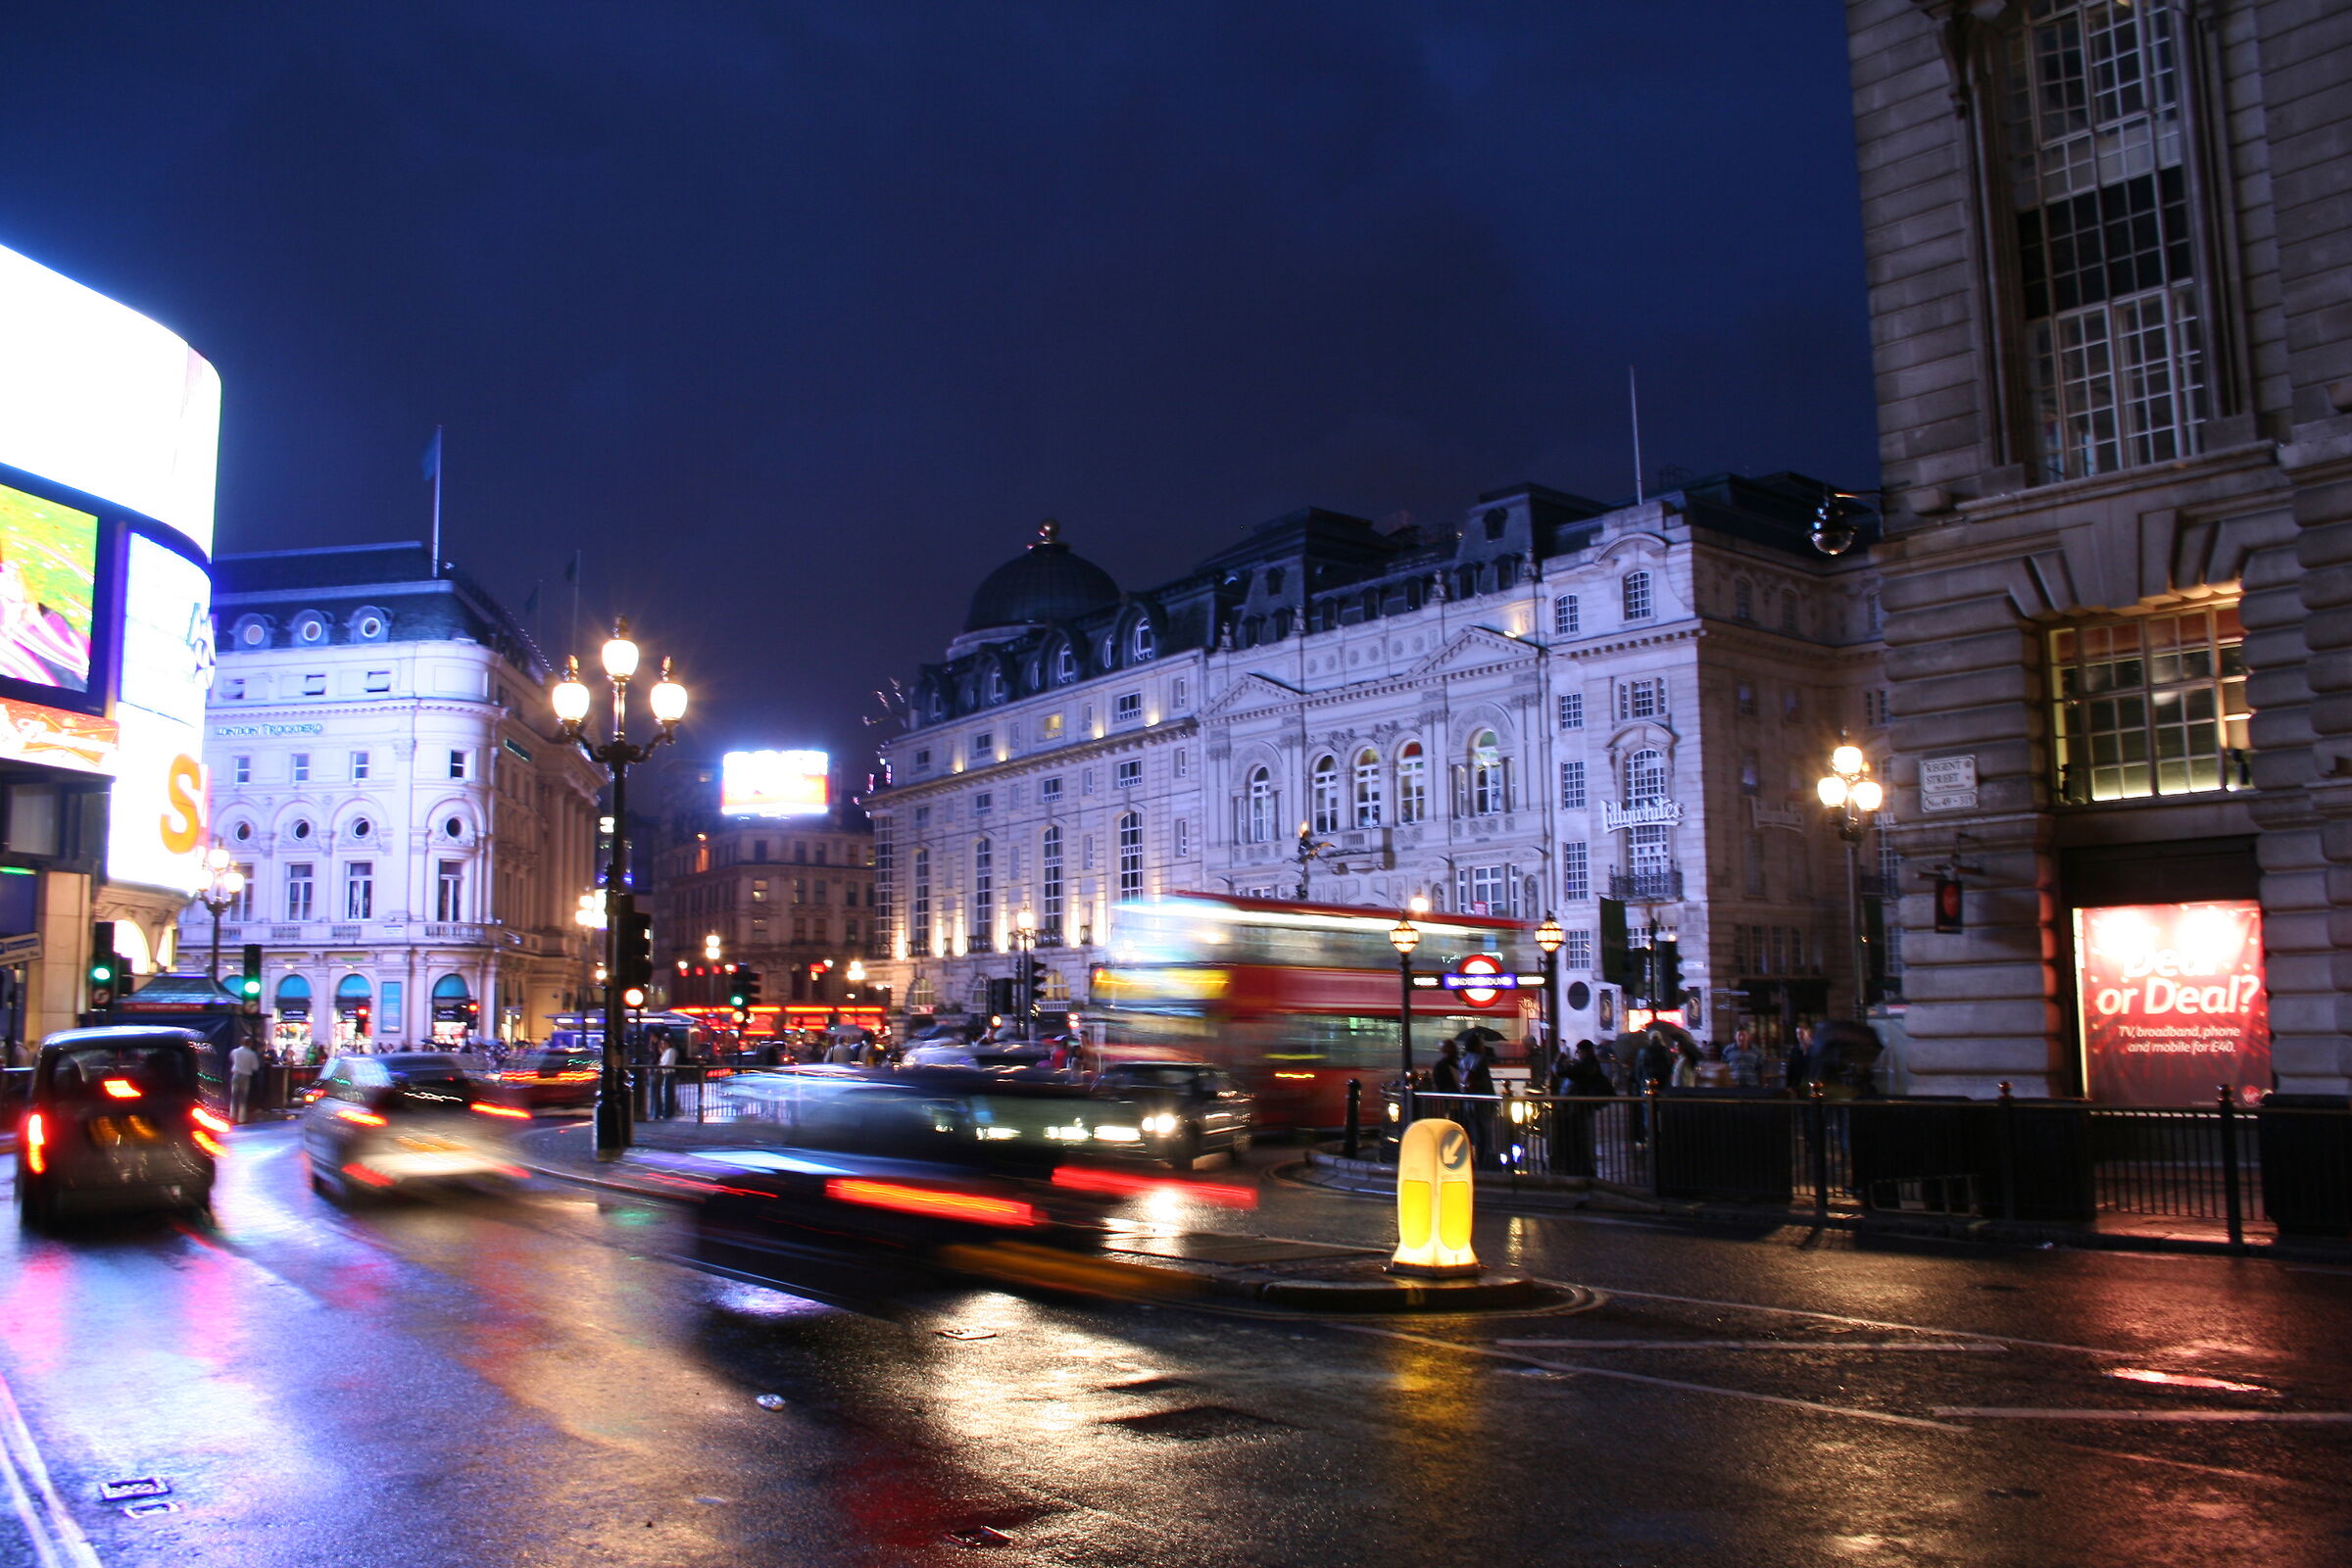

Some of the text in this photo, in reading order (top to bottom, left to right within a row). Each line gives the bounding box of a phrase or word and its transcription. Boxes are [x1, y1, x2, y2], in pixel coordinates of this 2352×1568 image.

[1925, 760, 1961, 772] REGENT
[1926, 773, 1959, 784] STREET
[1447, 976, 1512, 987] UNDEOUND
[2096, 974, 2261, 1015] or Deal?
[2118, 1025, 2241, 1040] TV, broadband, phone
[2128, 1041, 2151, 1053] and
[2152, 1040, 2191, 1053] mobile
[2191, 1040, 2210, 1055] for
